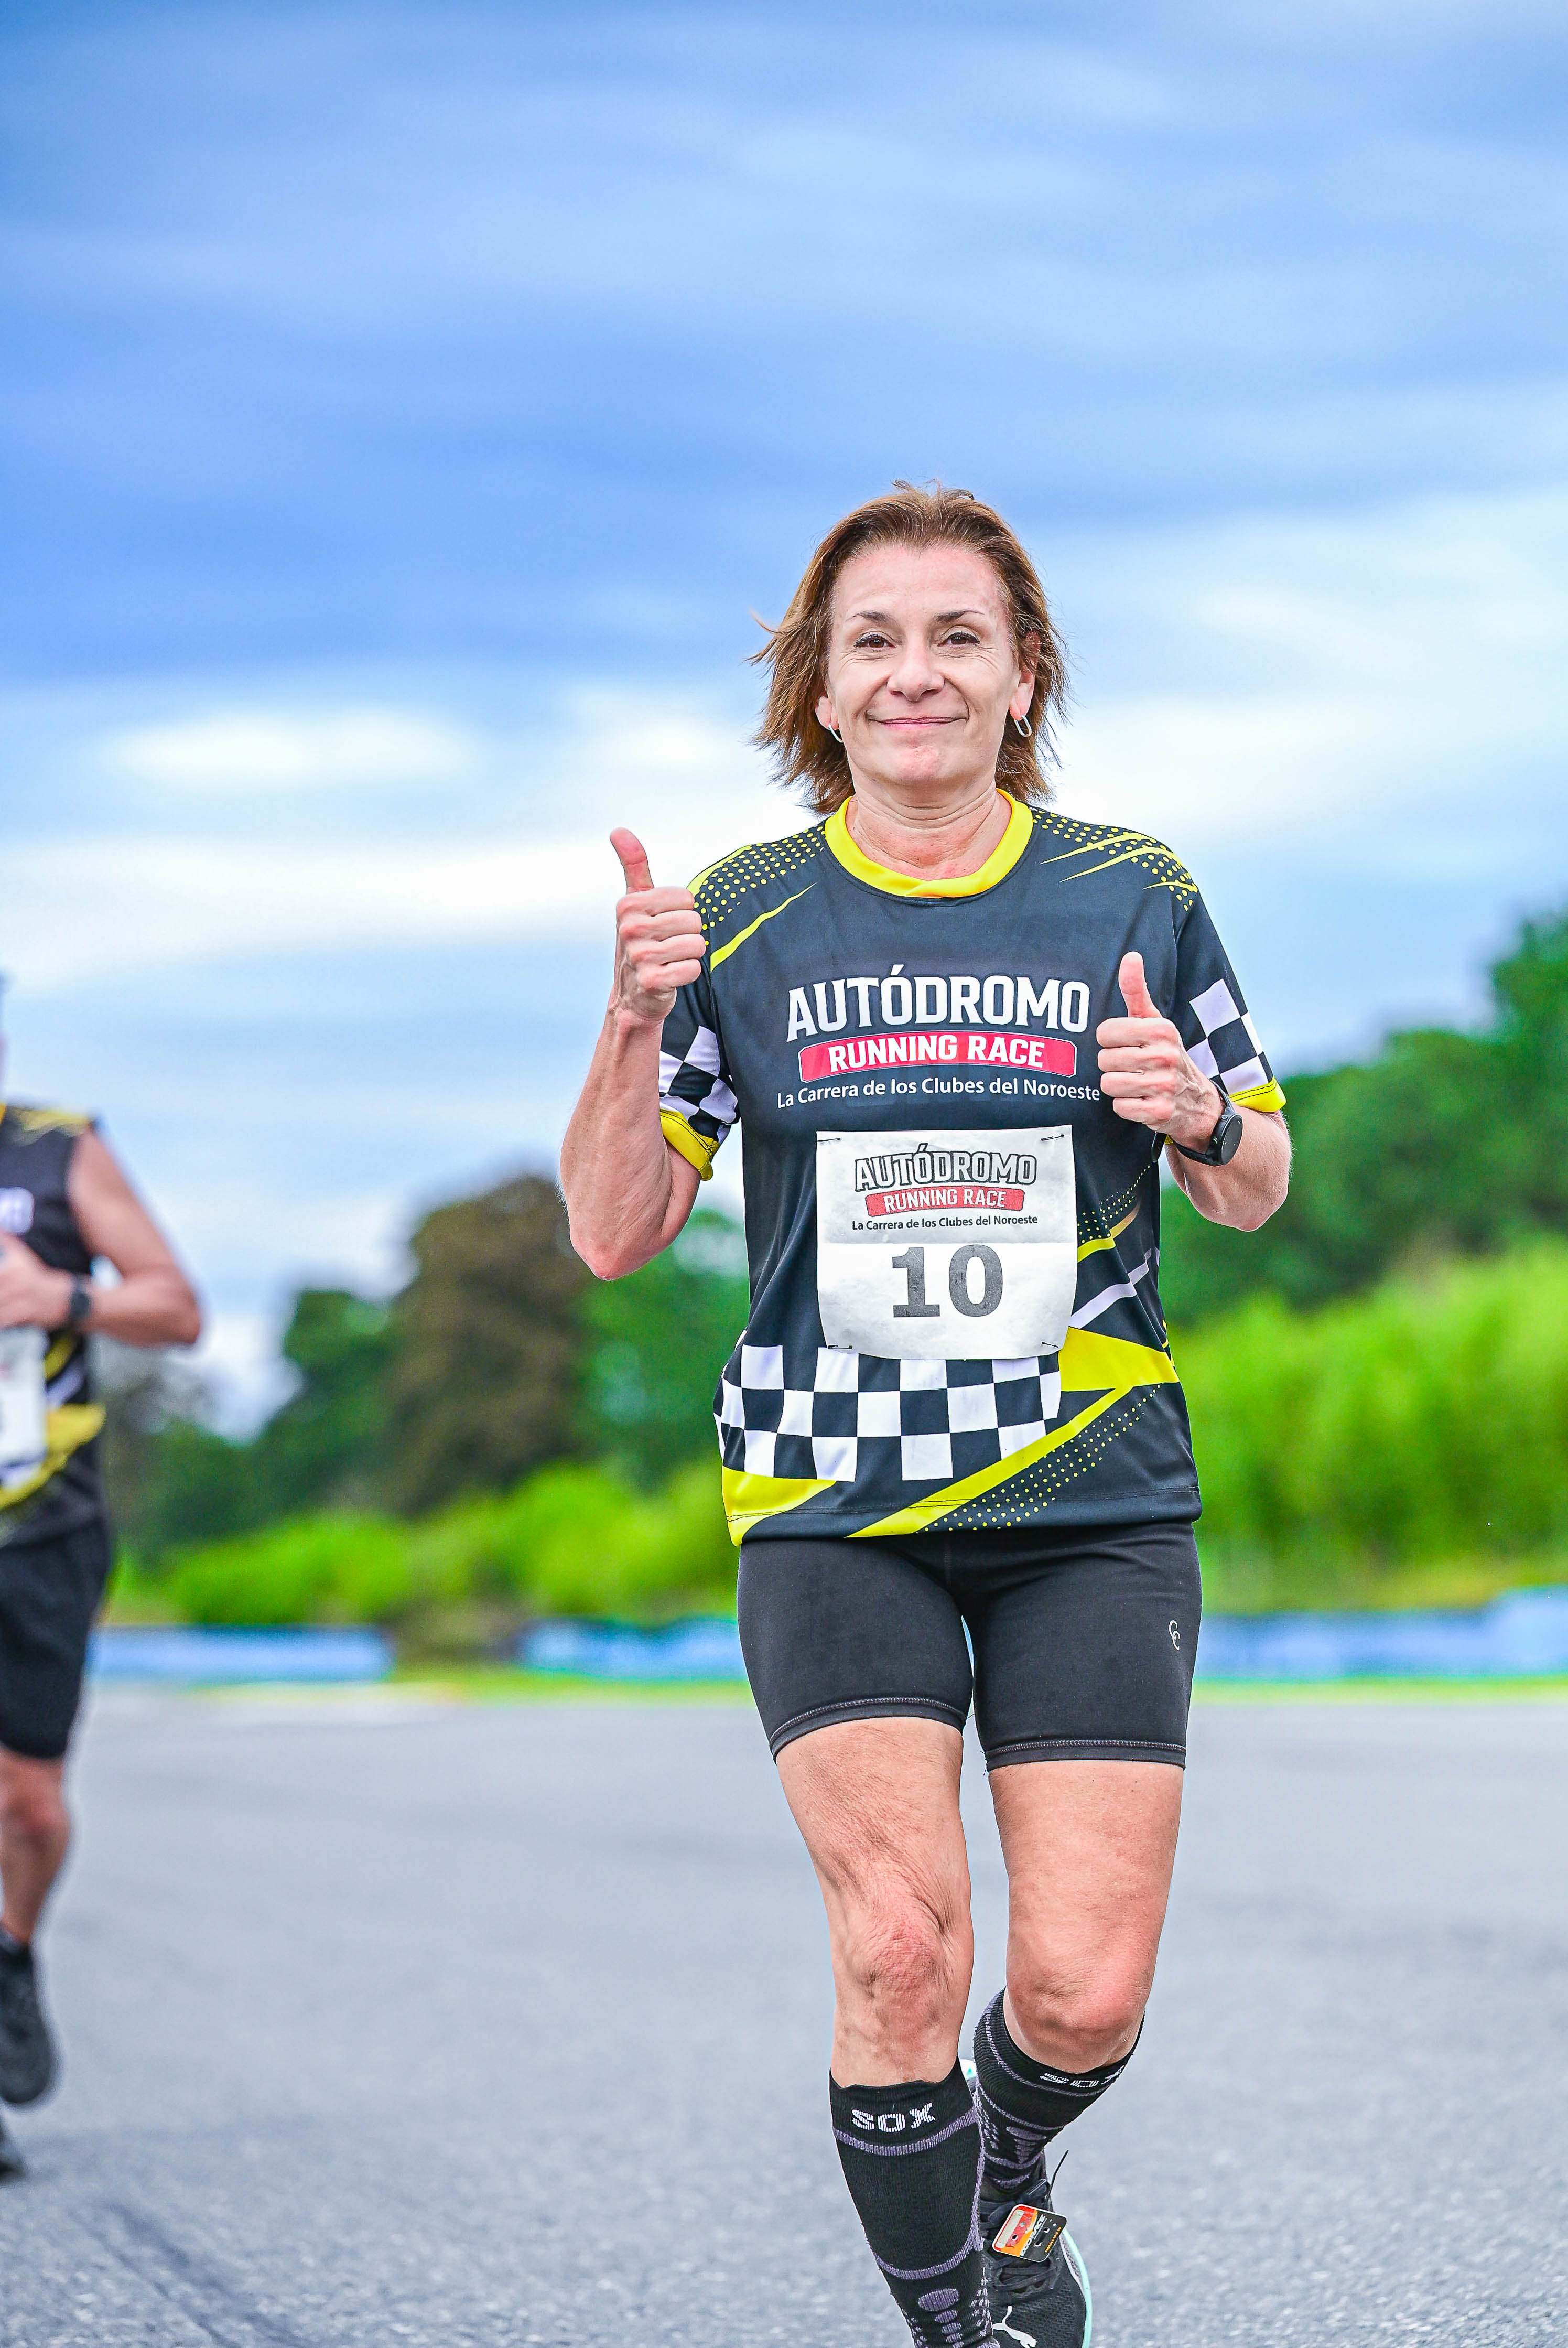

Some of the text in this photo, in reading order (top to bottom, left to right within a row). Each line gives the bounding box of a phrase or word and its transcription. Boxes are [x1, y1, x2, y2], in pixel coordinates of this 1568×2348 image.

[786, 964, 1090, 1042] AUTÓDROMO
[828, 1035, 1045, 1073] RUNNING RACE
[777, 1077, 1100, 1108] La Carrera de los Clubes del Noroeste
[855, 1143, 1037, 1191] AUTÓDROMO
[883, 1188, 1007, 1212] RUNNING RACE
[852, 1215, 1038, 1230] La Carrera de los Clubes del Noroeste
[892, 1244, 1003, 1317] 10
[851, 2102, 936, 2133] SOX
